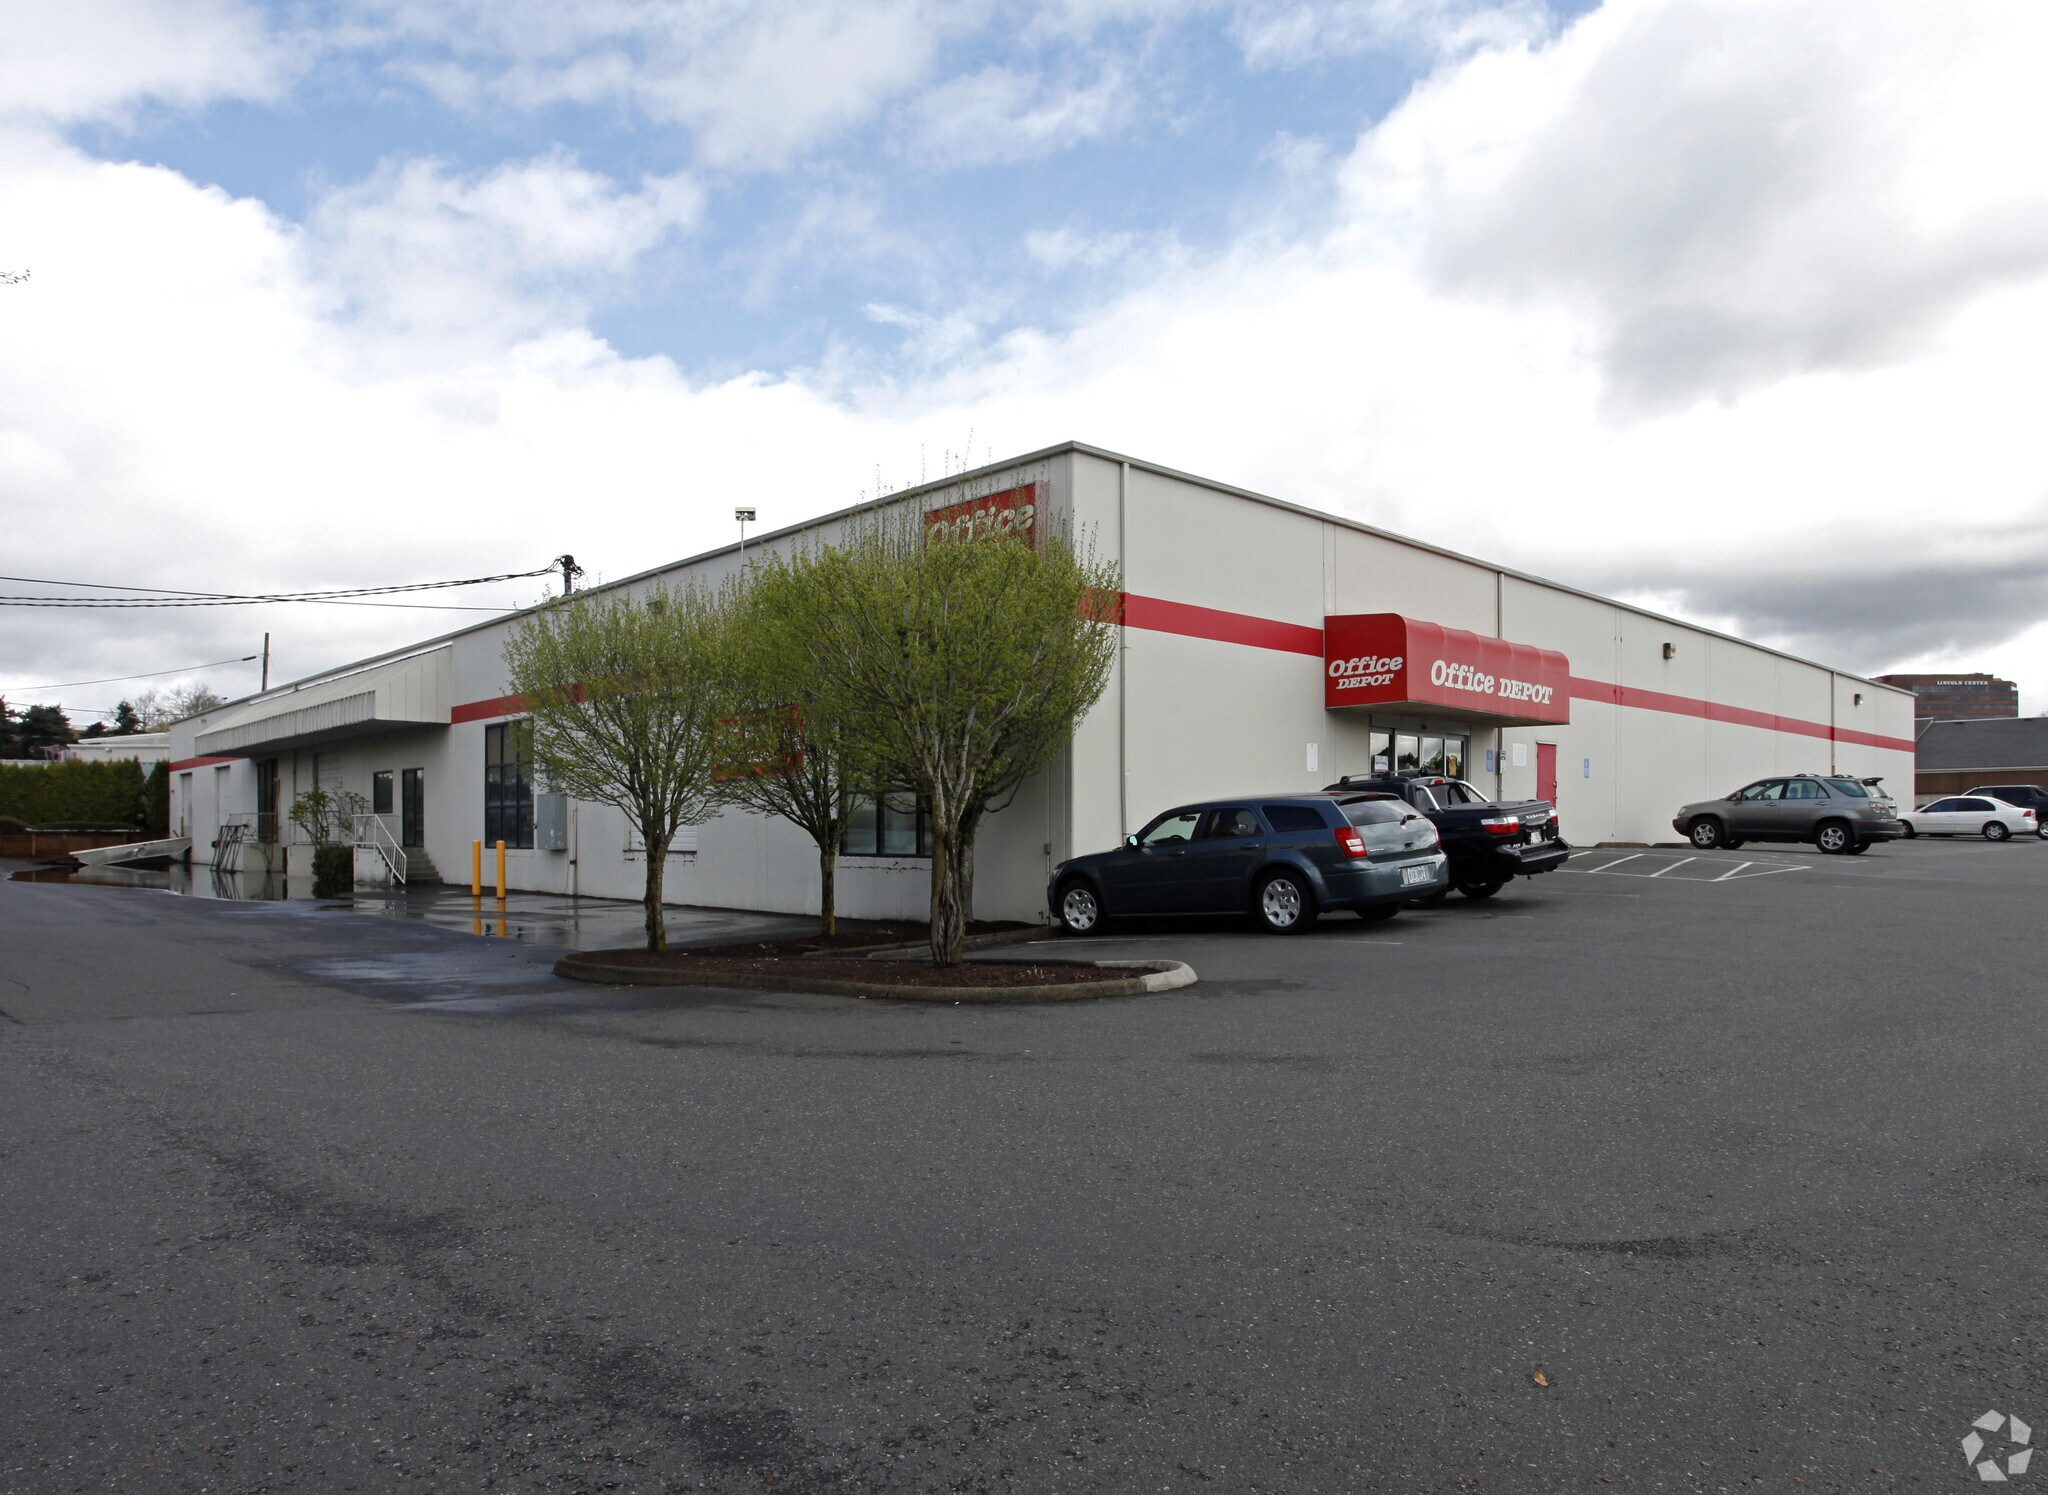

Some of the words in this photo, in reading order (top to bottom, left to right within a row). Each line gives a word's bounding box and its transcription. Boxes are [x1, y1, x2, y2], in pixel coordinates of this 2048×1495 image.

[1328, 655, 1403, 677] Office
[1336, 673, 1394, 690] DEPOT
[1431, 659, 1495, 694] Office
[1498, 678, 1553, 704] DEPOT
